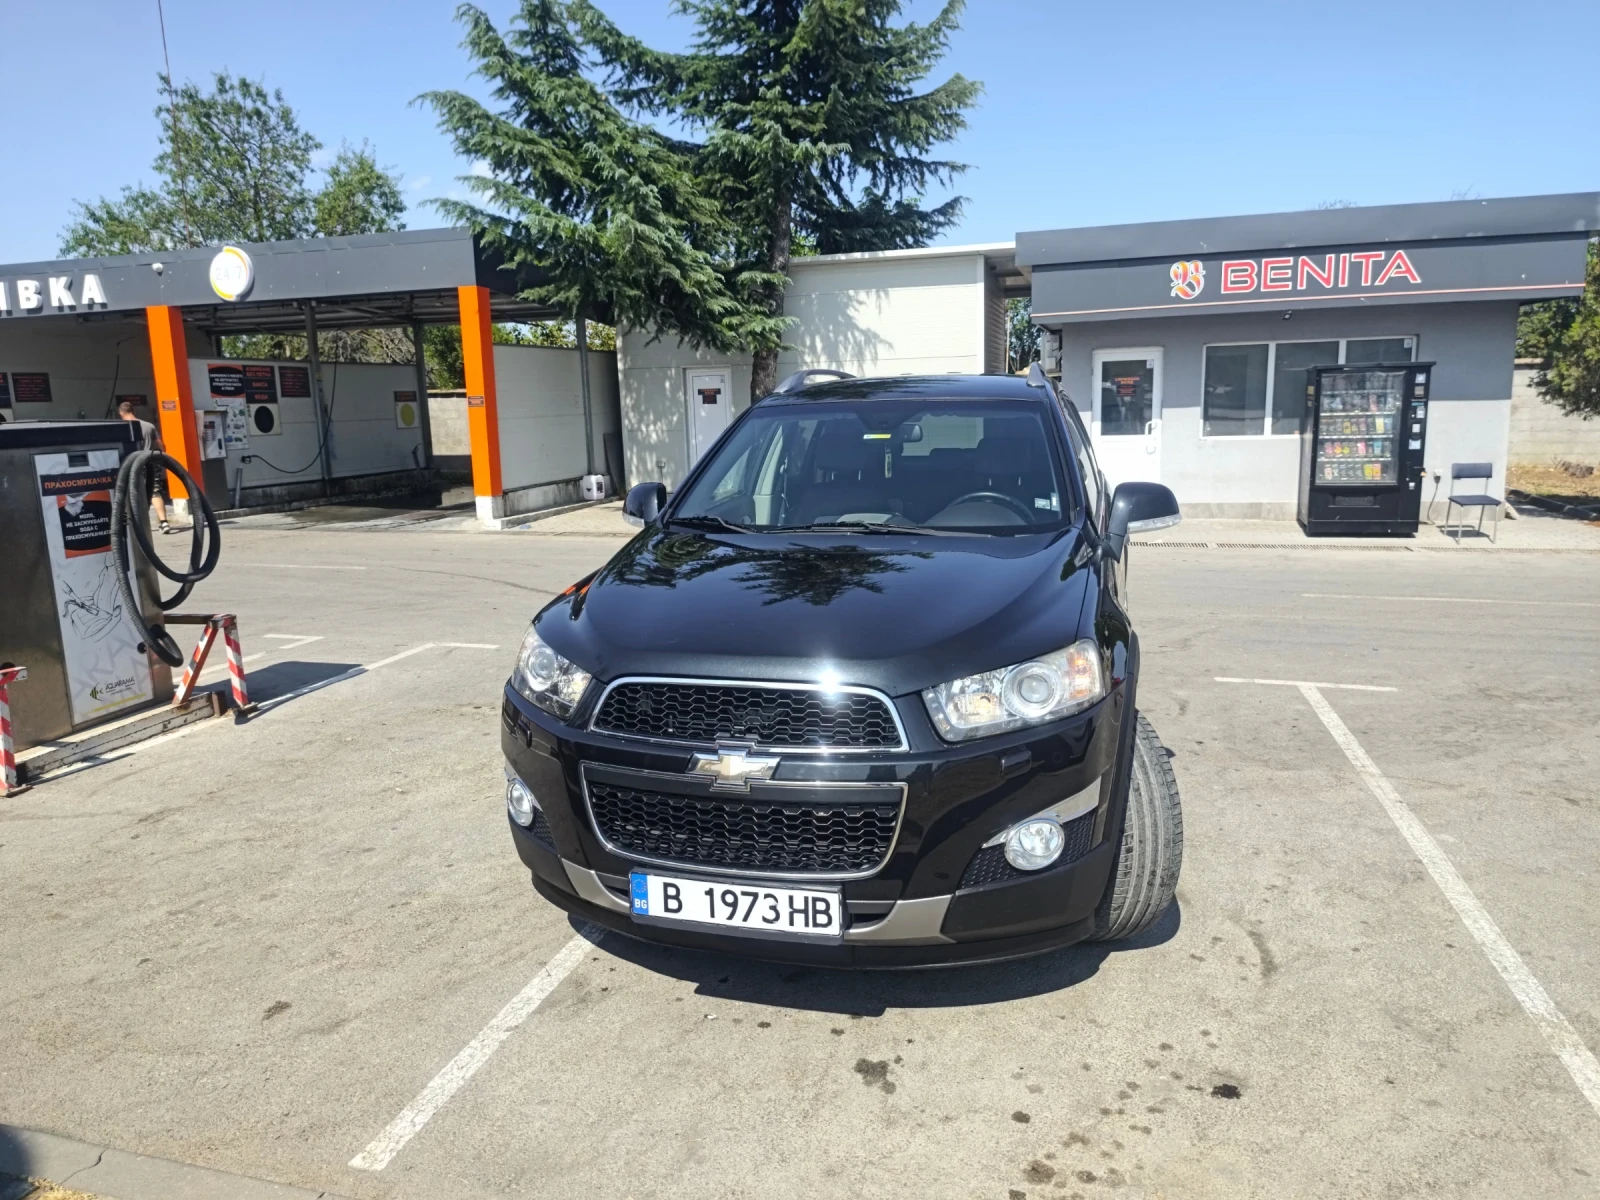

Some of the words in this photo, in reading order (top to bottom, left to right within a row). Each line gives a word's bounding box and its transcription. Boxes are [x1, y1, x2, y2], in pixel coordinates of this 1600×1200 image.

[1221, 250, 1422, 294] BENITA
[44, 476, 112, 489] ПРАХОСМУКАЧКА
[634, 898, 648, 910] BG
[662, 881, 683, 914] B
[704, 887, 781, 924] 1973
[788, 894, 833, 929] HB
